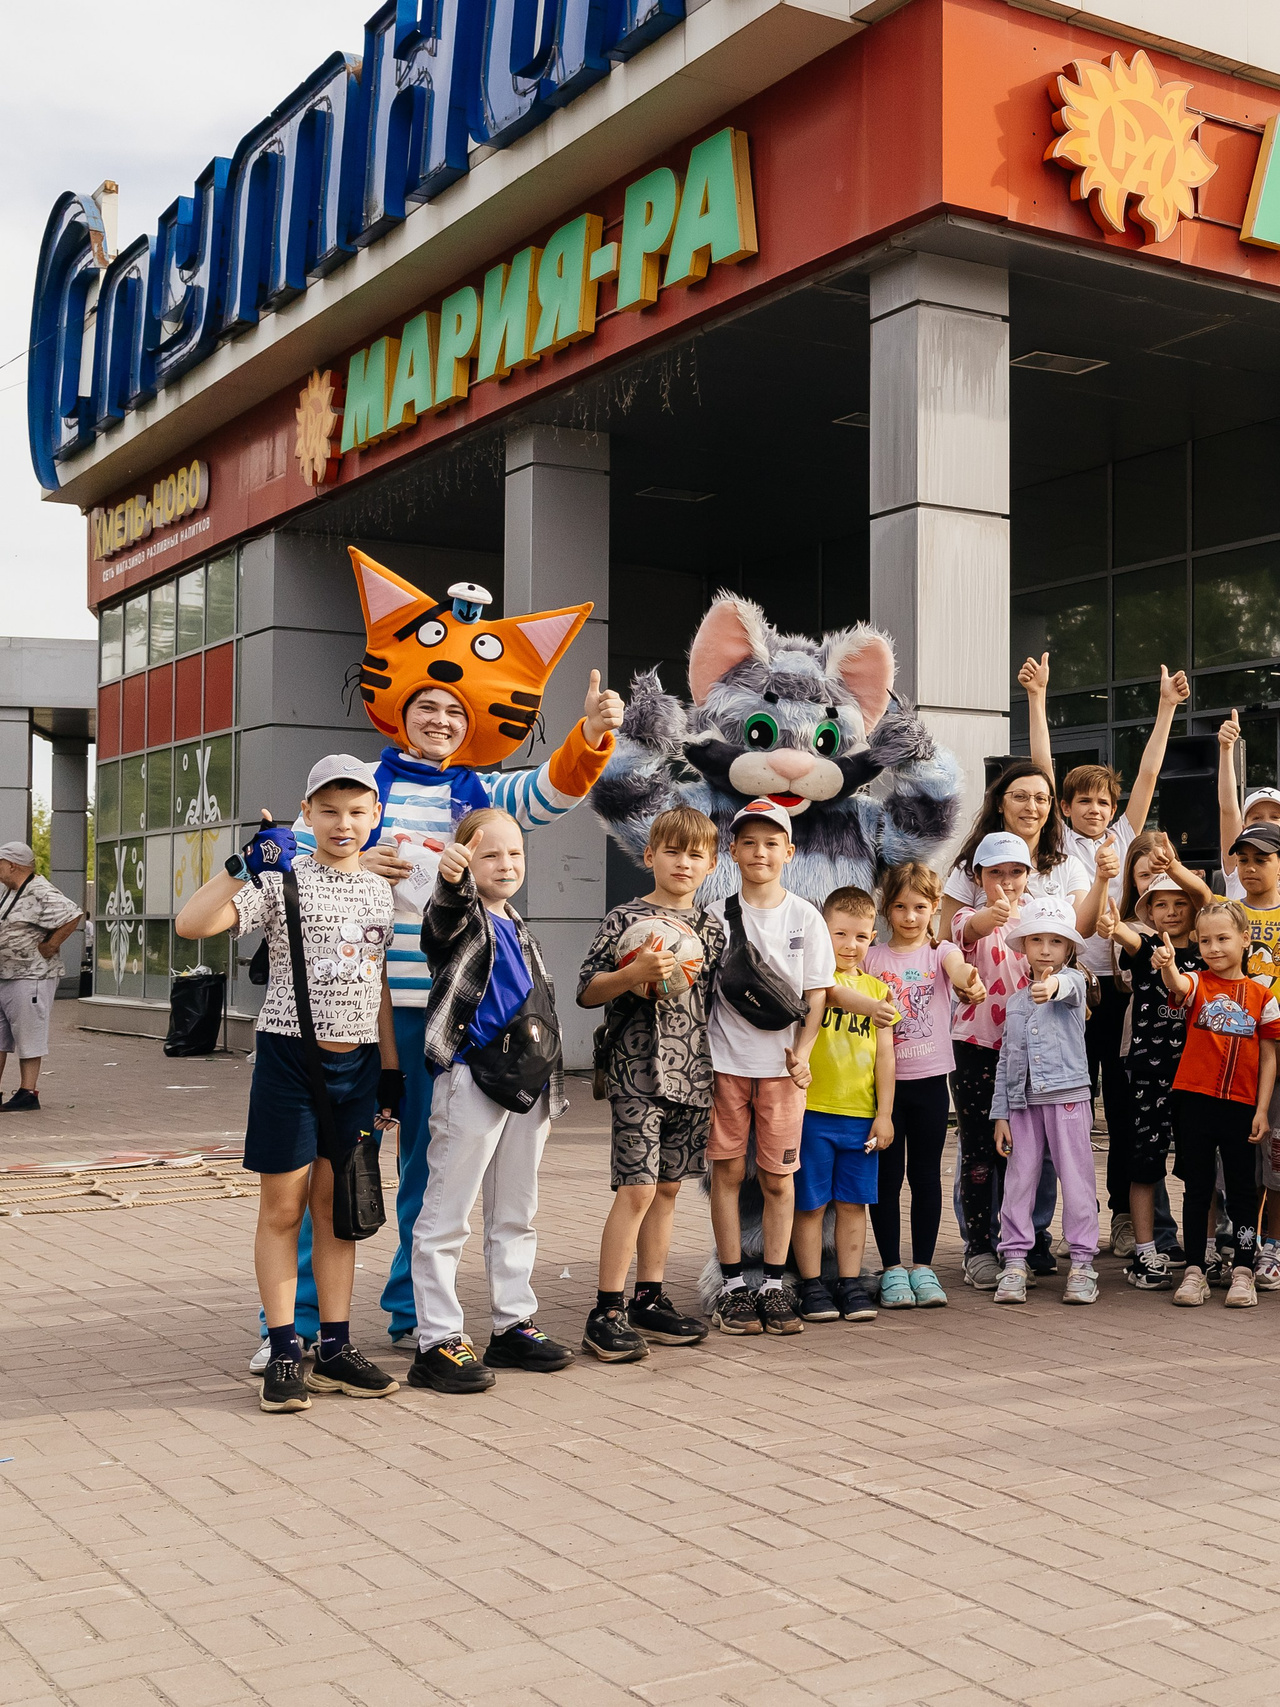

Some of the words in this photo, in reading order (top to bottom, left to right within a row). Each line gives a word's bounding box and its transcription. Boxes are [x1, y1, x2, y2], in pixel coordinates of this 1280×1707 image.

[340, 127, 758, 456] МАРИЯ-РА
[102, 565, 116, 583] СЕТЬ
[115, 550, 146, 576] МАГАЗИНОВ
[146, 533, 179, 560] РАЗЛИВНЫХ
[180, 516, 211, 544] НАПИТКОВ
[317, 903, 357, 914] REALLY?
[311, 1009, 348, 1019] EALLY?
[895, 1041, 936, 1060] ANYTHING
